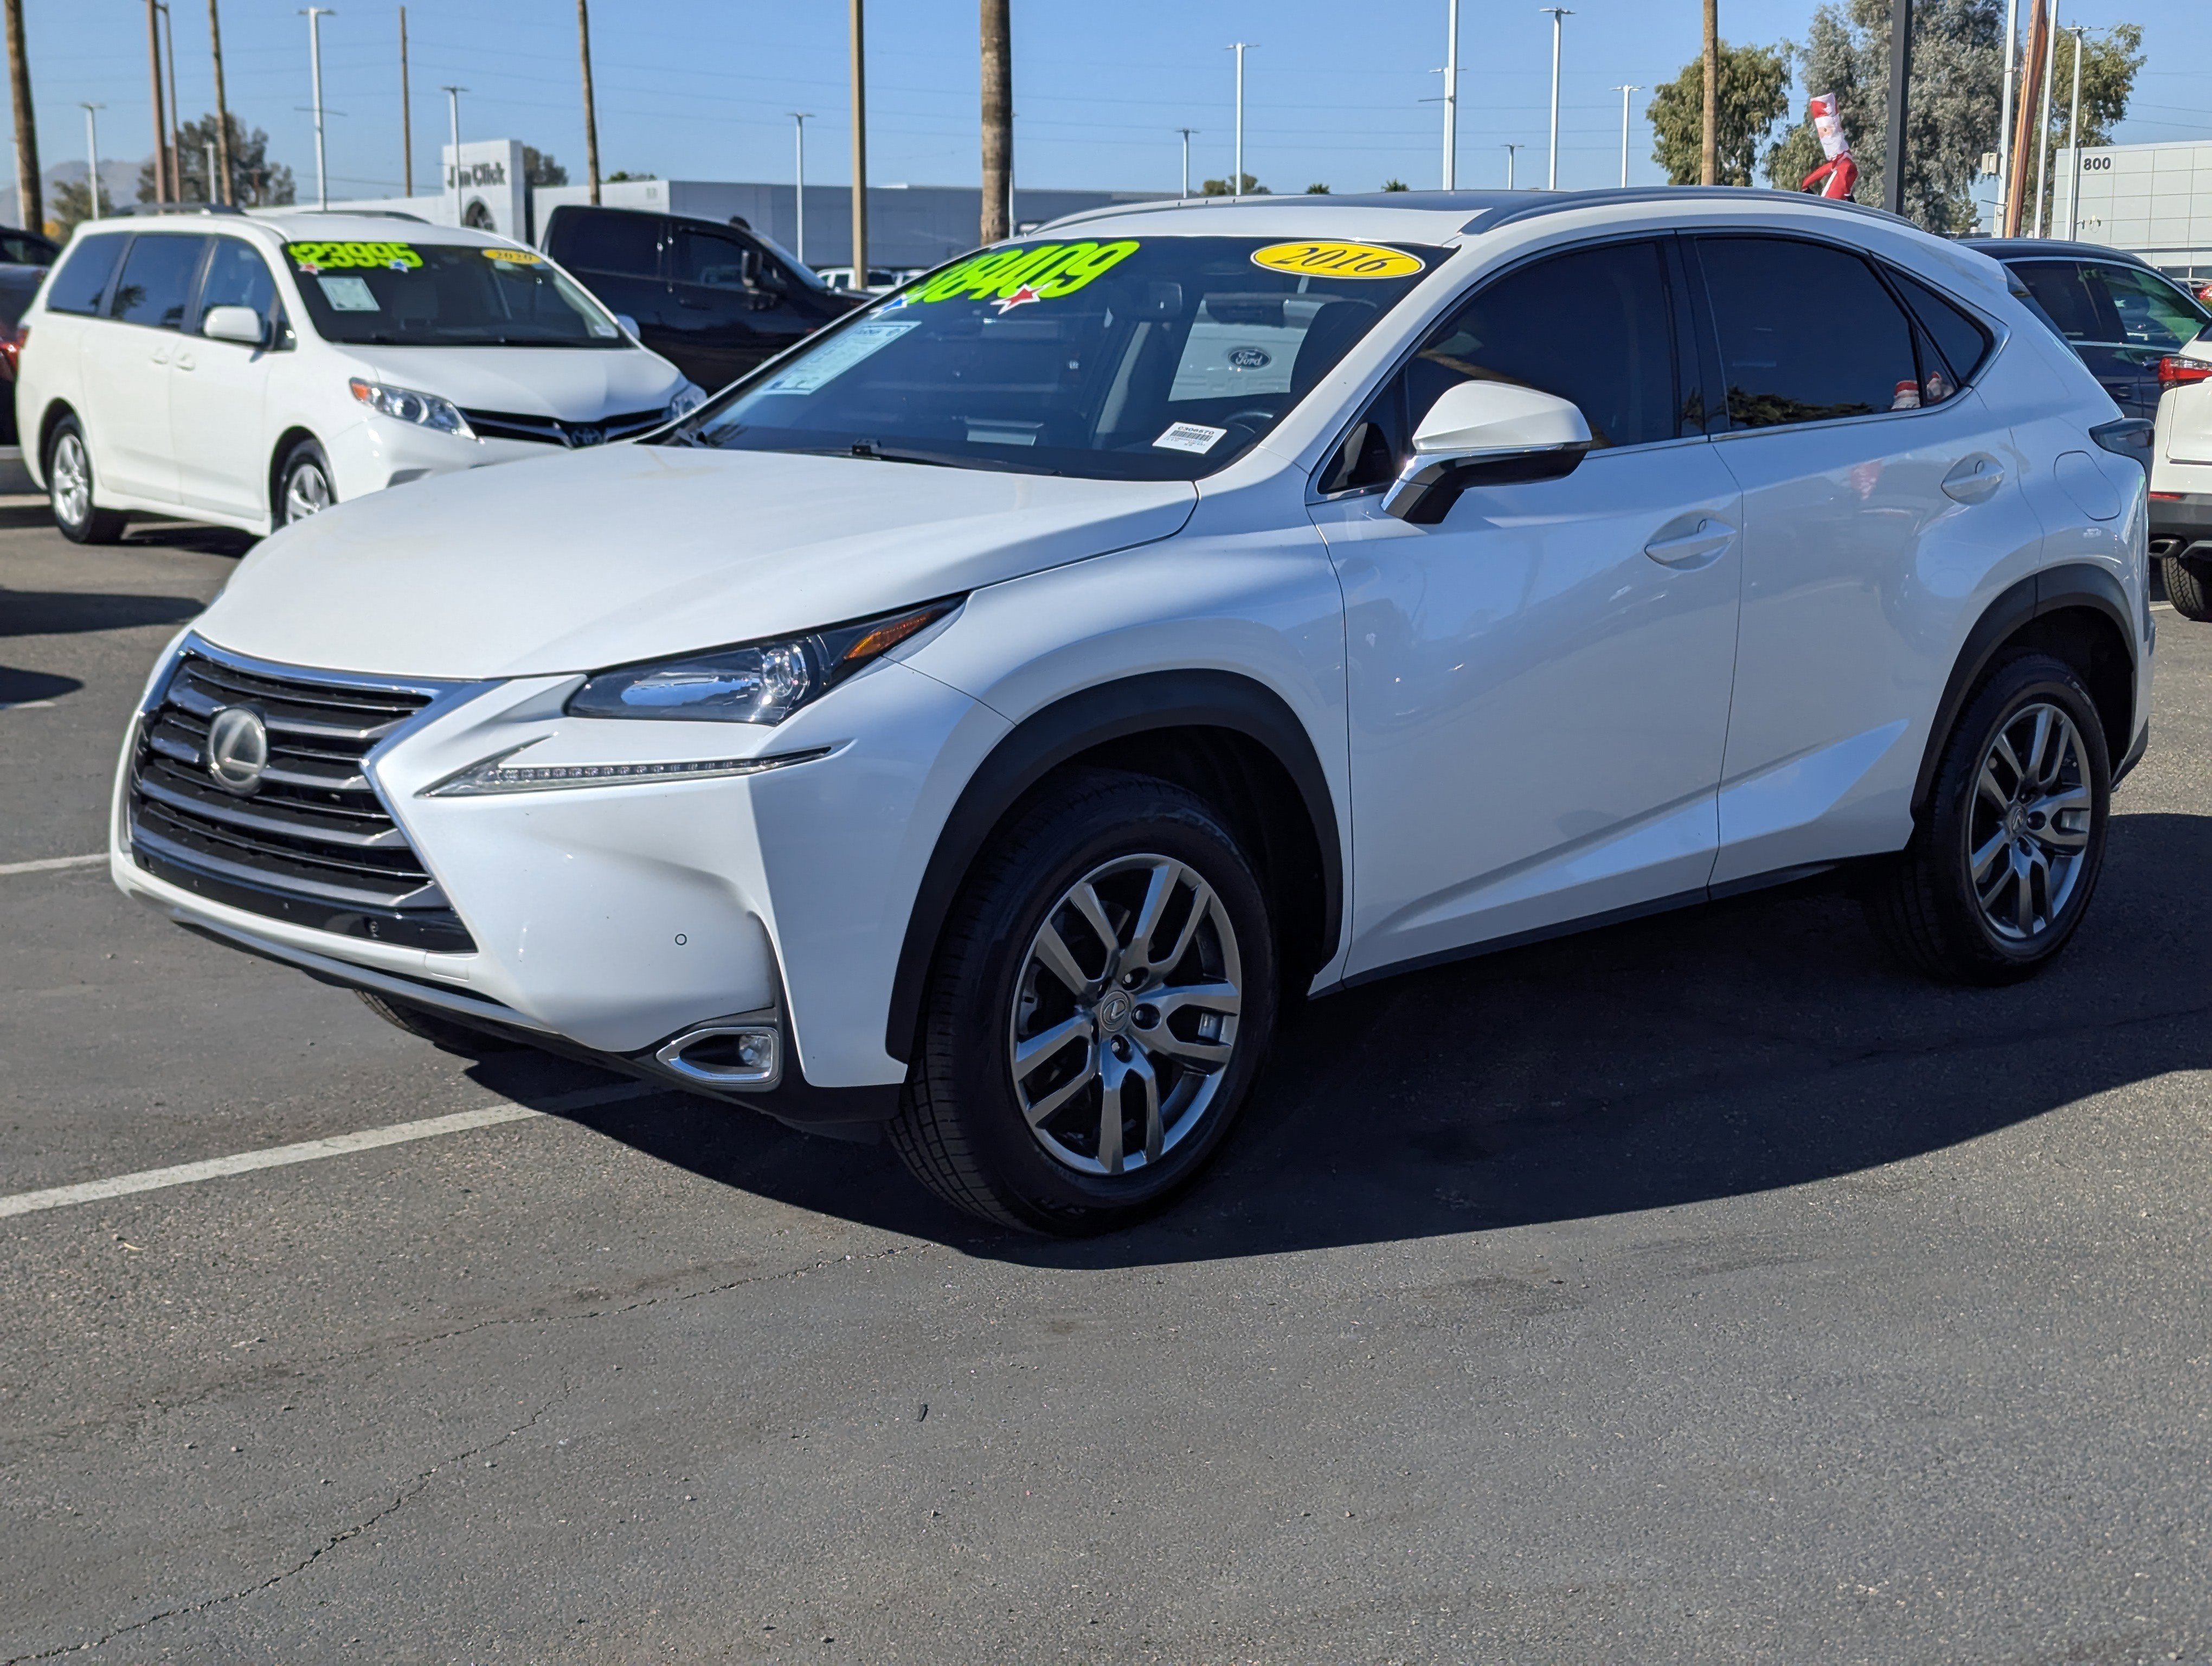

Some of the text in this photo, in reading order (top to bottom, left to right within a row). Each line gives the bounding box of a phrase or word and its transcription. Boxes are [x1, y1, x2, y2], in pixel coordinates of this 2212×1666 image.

[2083, 156, 2111, 171] 800
[447, 165, 471, 189] Jm
[287, 241, 423, 268] $23995
[1269, 247, 1407, 273] 2016
[1235, 351, 1263, 366] Ford
